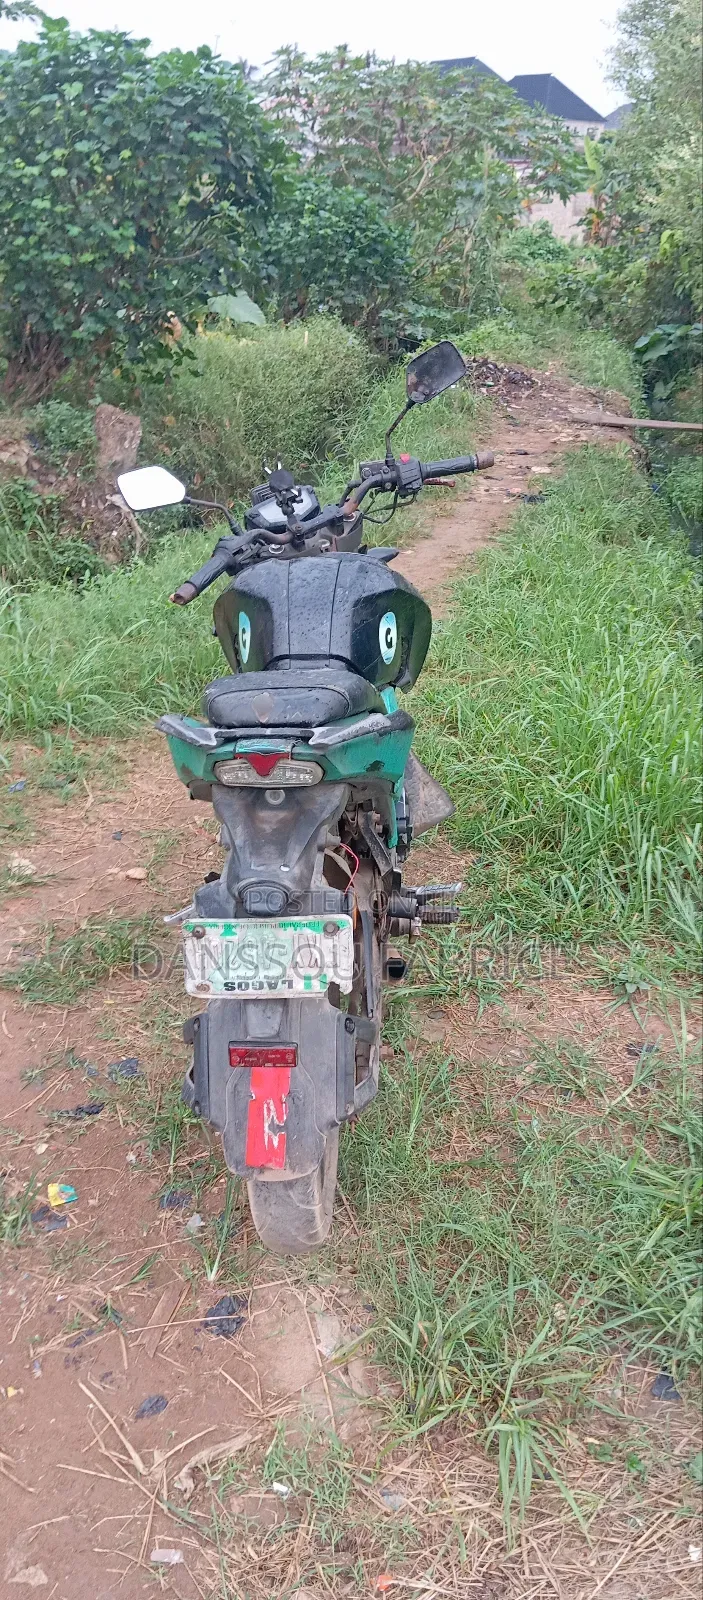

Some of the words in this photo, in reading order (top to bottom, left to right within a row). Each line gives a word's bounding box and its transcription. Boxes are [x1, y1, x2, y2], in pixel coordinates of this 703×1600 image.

[241, 627, 247, 650] G
[385, 627, 393, 649] G
[223, 979, 294, 992] LAGOS
